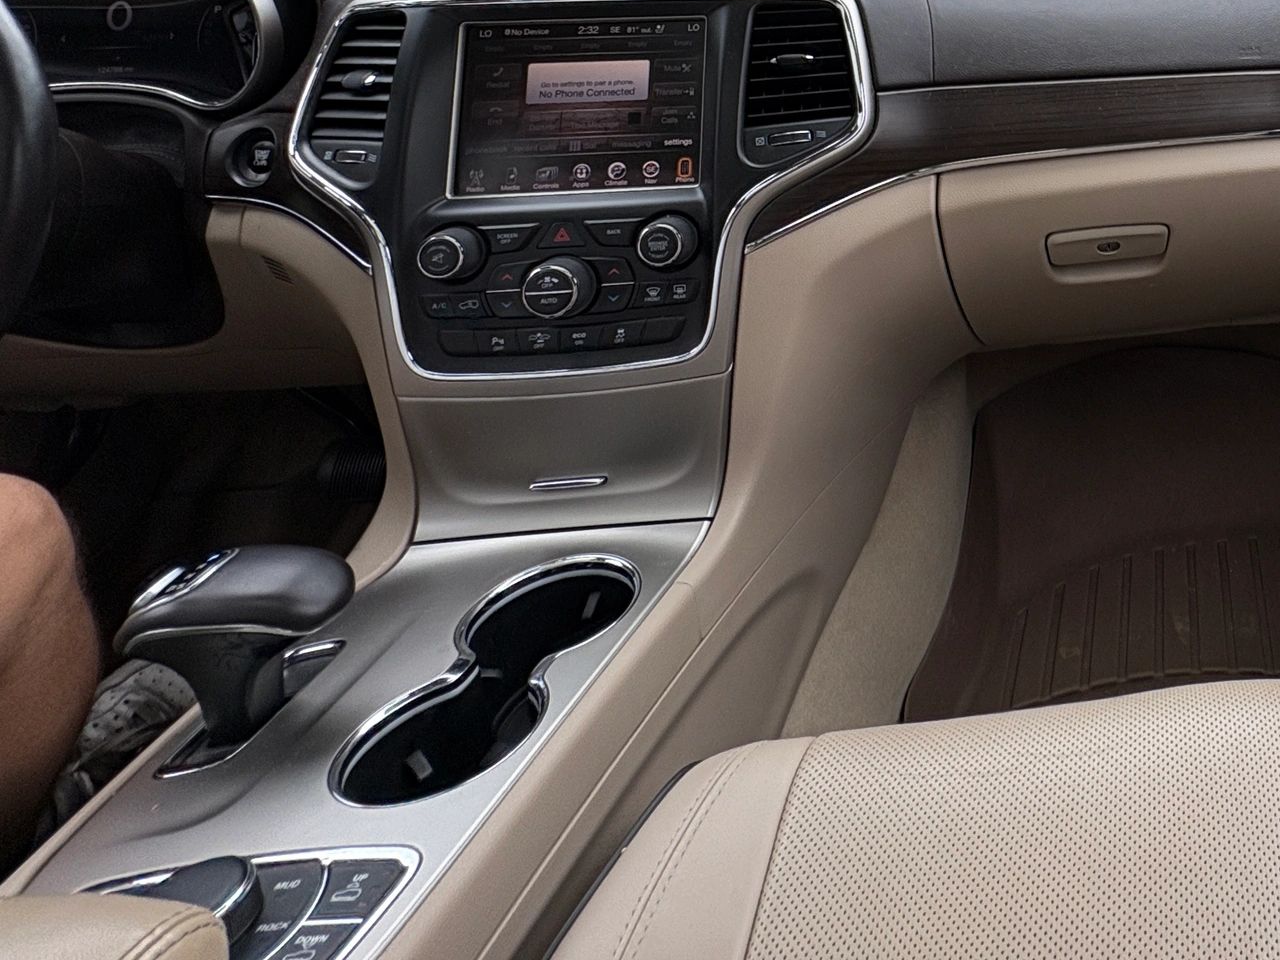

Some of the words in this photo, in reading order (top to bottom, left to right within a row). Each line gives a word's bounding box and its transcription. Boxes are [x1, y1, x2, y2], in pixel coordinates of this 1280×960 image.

[524, 26, 550, 36] Device
[577, 25, 600, 36] 2:32
[609, 25, 621, 34] SE
[688, 23, 700, 33] LO
[479, 29, 493, 38] LO
[539, 89, 553, 99] No
[554, 89, 584, 98] Phone
[586, 87, 636, 97] Connected
[664, 138, 693, 148] settings
[532, 182, 560, 190] Controls
[572, 180, 590, 189] Apps
[604, 178, 628, 186] Climate
[496, 232, 518, 240] SCREEN
[540, 297, 558, 305] AUTO
[432, 302, 447, 310] A/C
[572, 332, 587, 340] eco
[353, 873, 370, 883] UP
[273, 878, 302, 891] MUD
[255, 921, 290, 934] ROCK
[294, 934, 330, 945] DOWN
